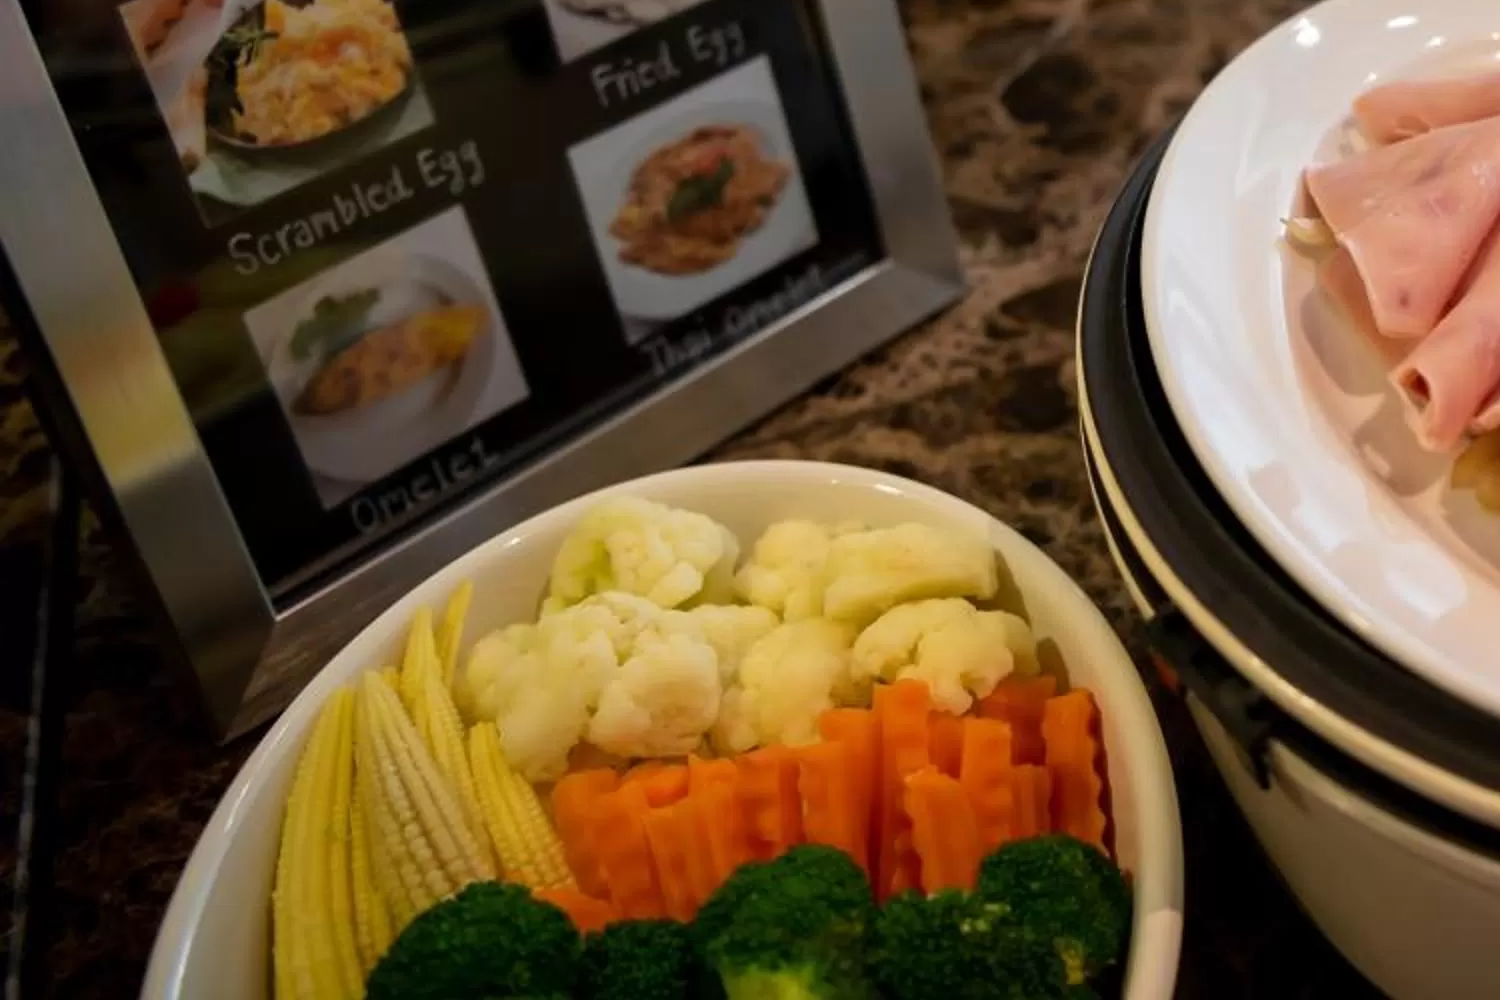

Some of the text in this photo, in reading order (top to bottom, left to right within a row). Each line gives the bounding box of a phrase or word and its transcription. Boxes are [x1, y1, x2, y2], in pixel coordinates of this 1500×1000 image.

[591, 19, 745, 106] Fried Egg
[228, 137, 486, 277] Scrambled Egg
